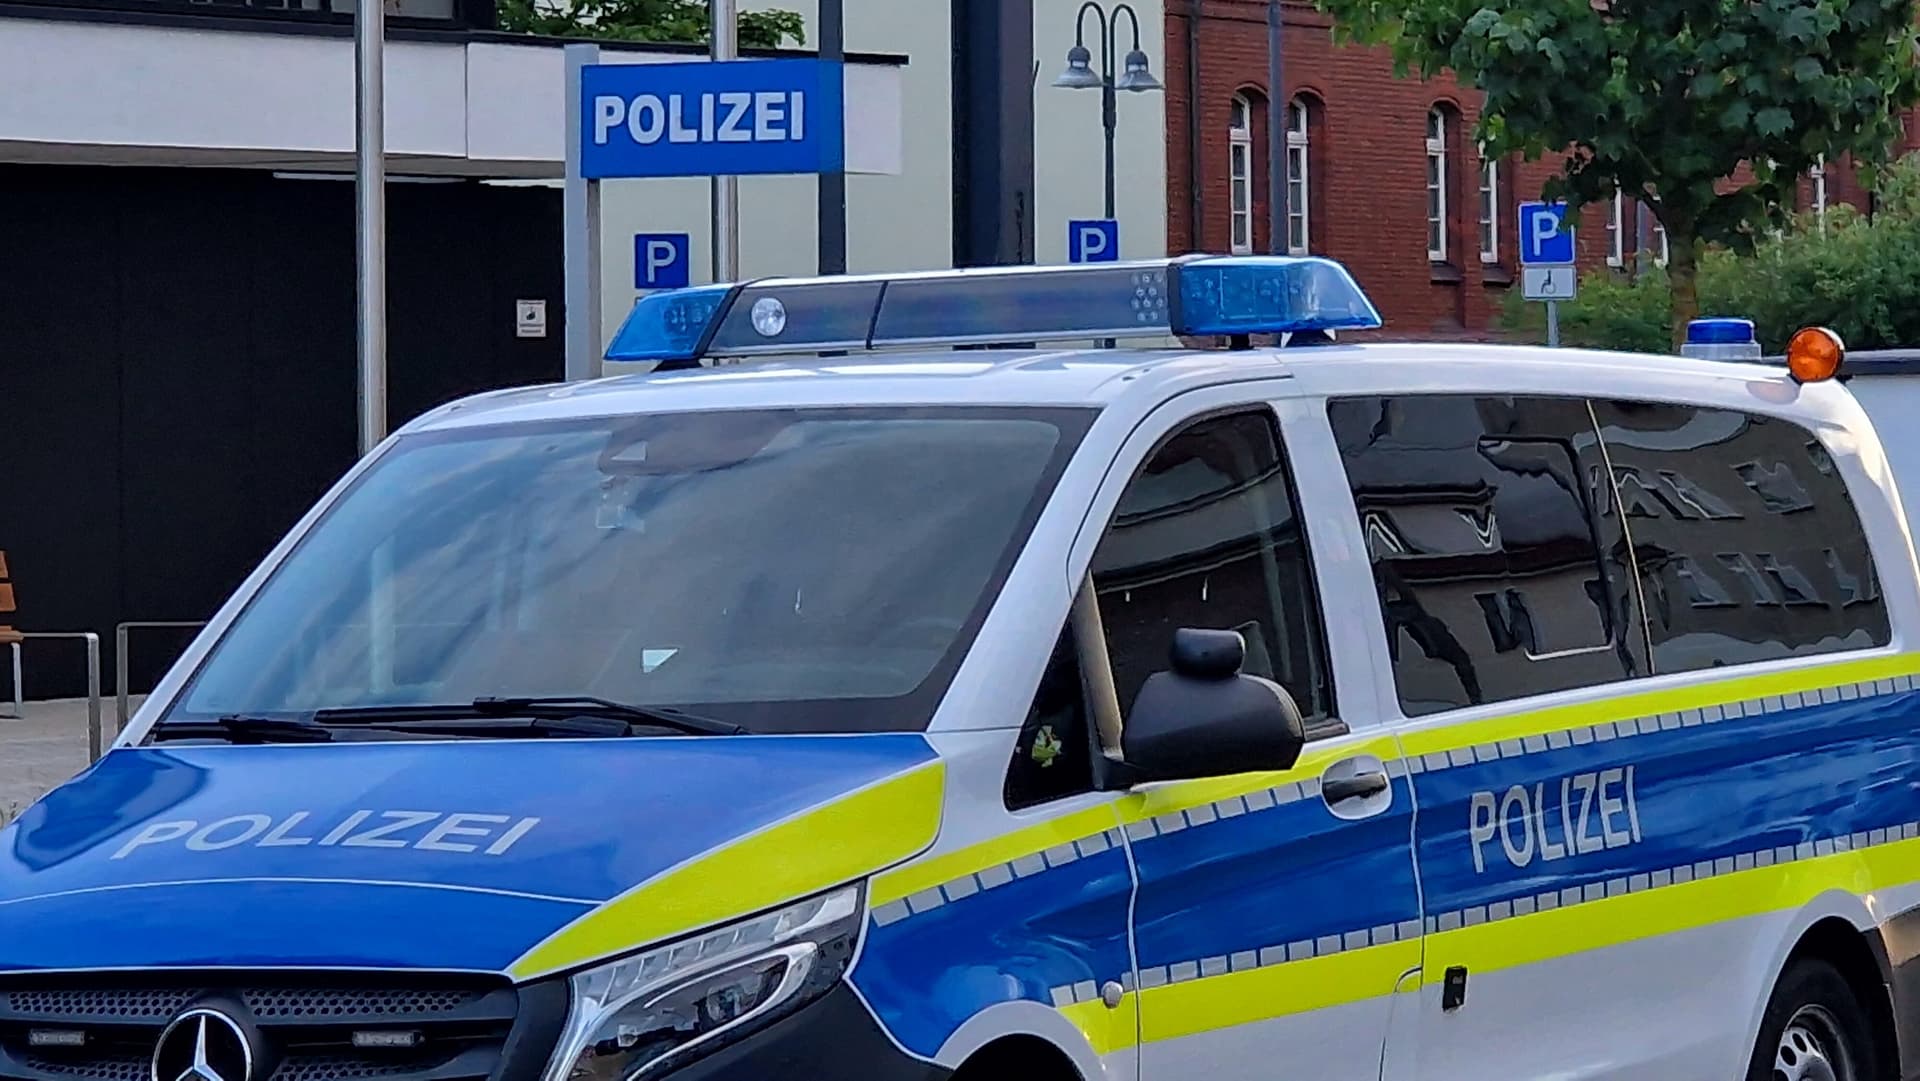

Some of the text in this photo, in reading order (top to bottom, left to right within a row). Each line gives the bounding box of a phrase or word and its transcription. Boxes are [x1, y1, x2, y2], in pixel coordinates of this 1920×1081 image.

[594, 91, 803, 144] POLIZEI
[1080, 227, 1106, 263] P
[1533, 211, 1560, 256] P
[647, 240, 676, 283] P
[109, 809, 541, 860] POLIZEI
[1470, 765, 1641, 873] POLIZEI
